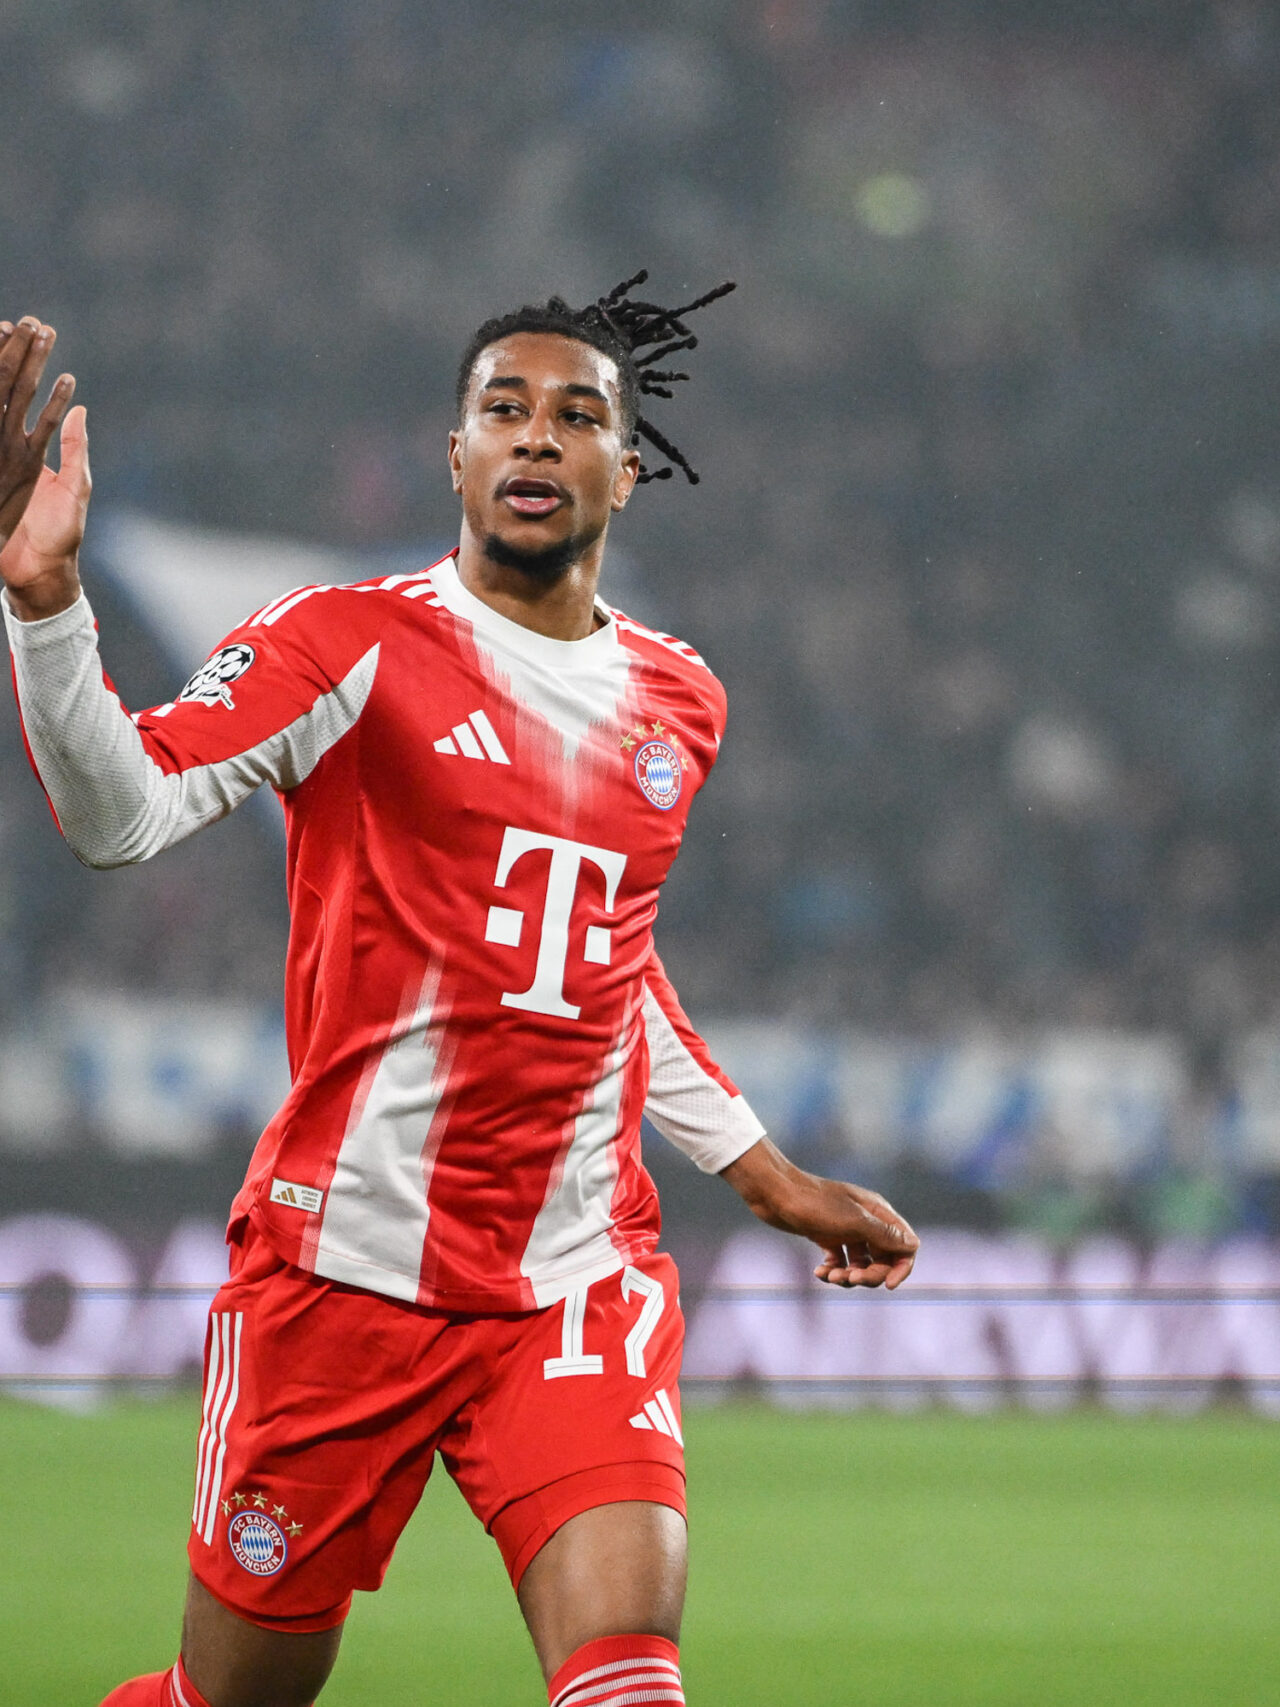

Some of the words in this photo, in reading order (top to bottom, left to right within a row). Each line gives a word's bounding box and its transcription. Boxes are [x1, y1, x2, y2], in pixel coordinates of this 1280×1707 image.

[648, 746, 680, 776] BAYERN
[485, 826, 628, 1020] T
[543, 1264, 666, 1380] 17
[233, 1518, 246, 1533] FC
[245, 1515, 282, 1546] BAYERN
[233, 1542, 281, 1572] MÜNCHEN
